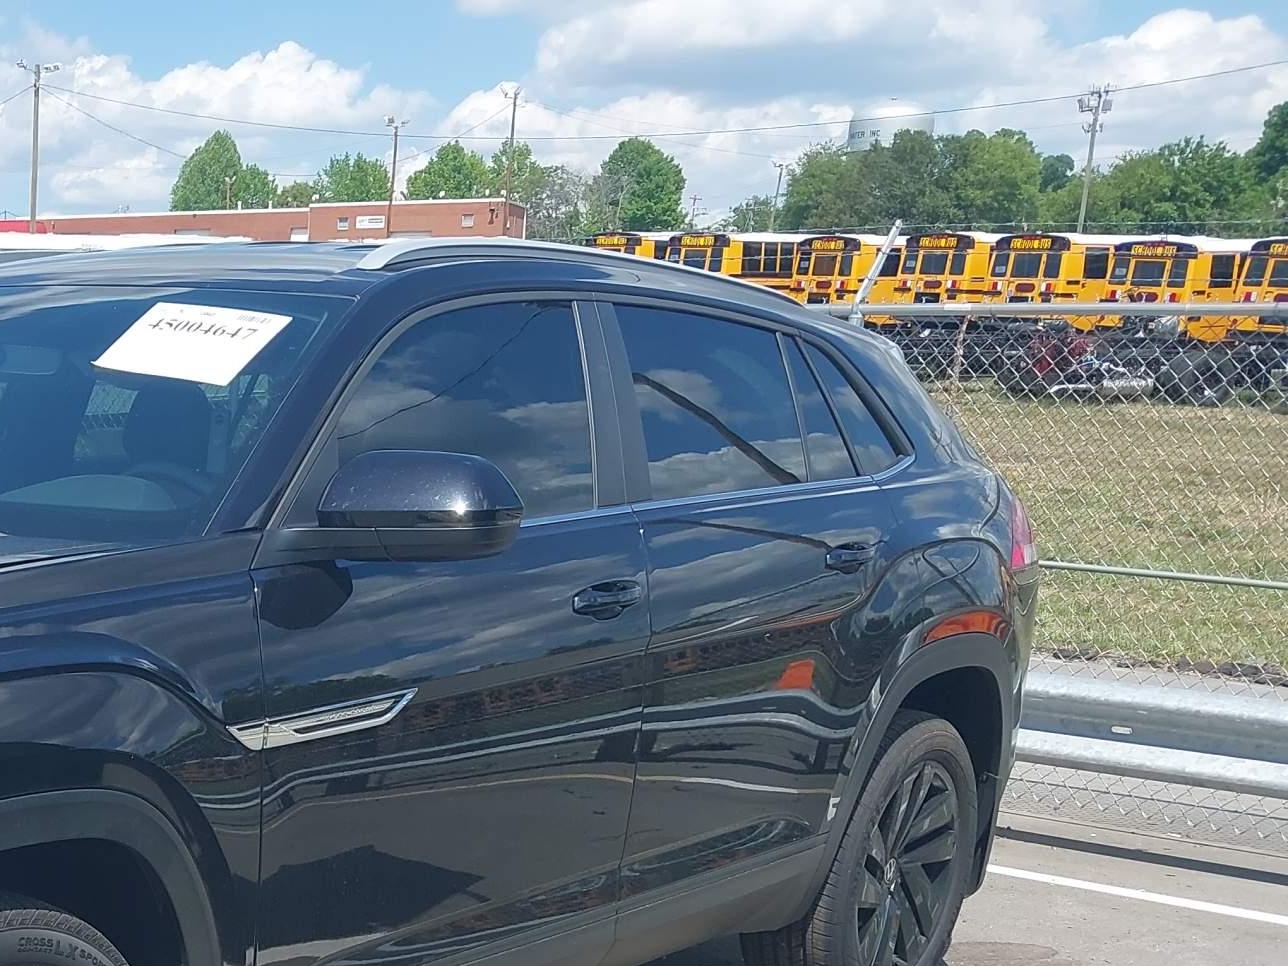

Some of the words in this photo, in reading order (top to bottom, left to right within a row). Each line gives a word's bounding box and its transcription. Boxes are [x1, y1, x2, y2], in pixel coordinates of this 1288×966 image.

[149, 317, 259, 340] 45004647
[17, 937, 54, 948] CROSS
[54, 940, 79, 960] LX
